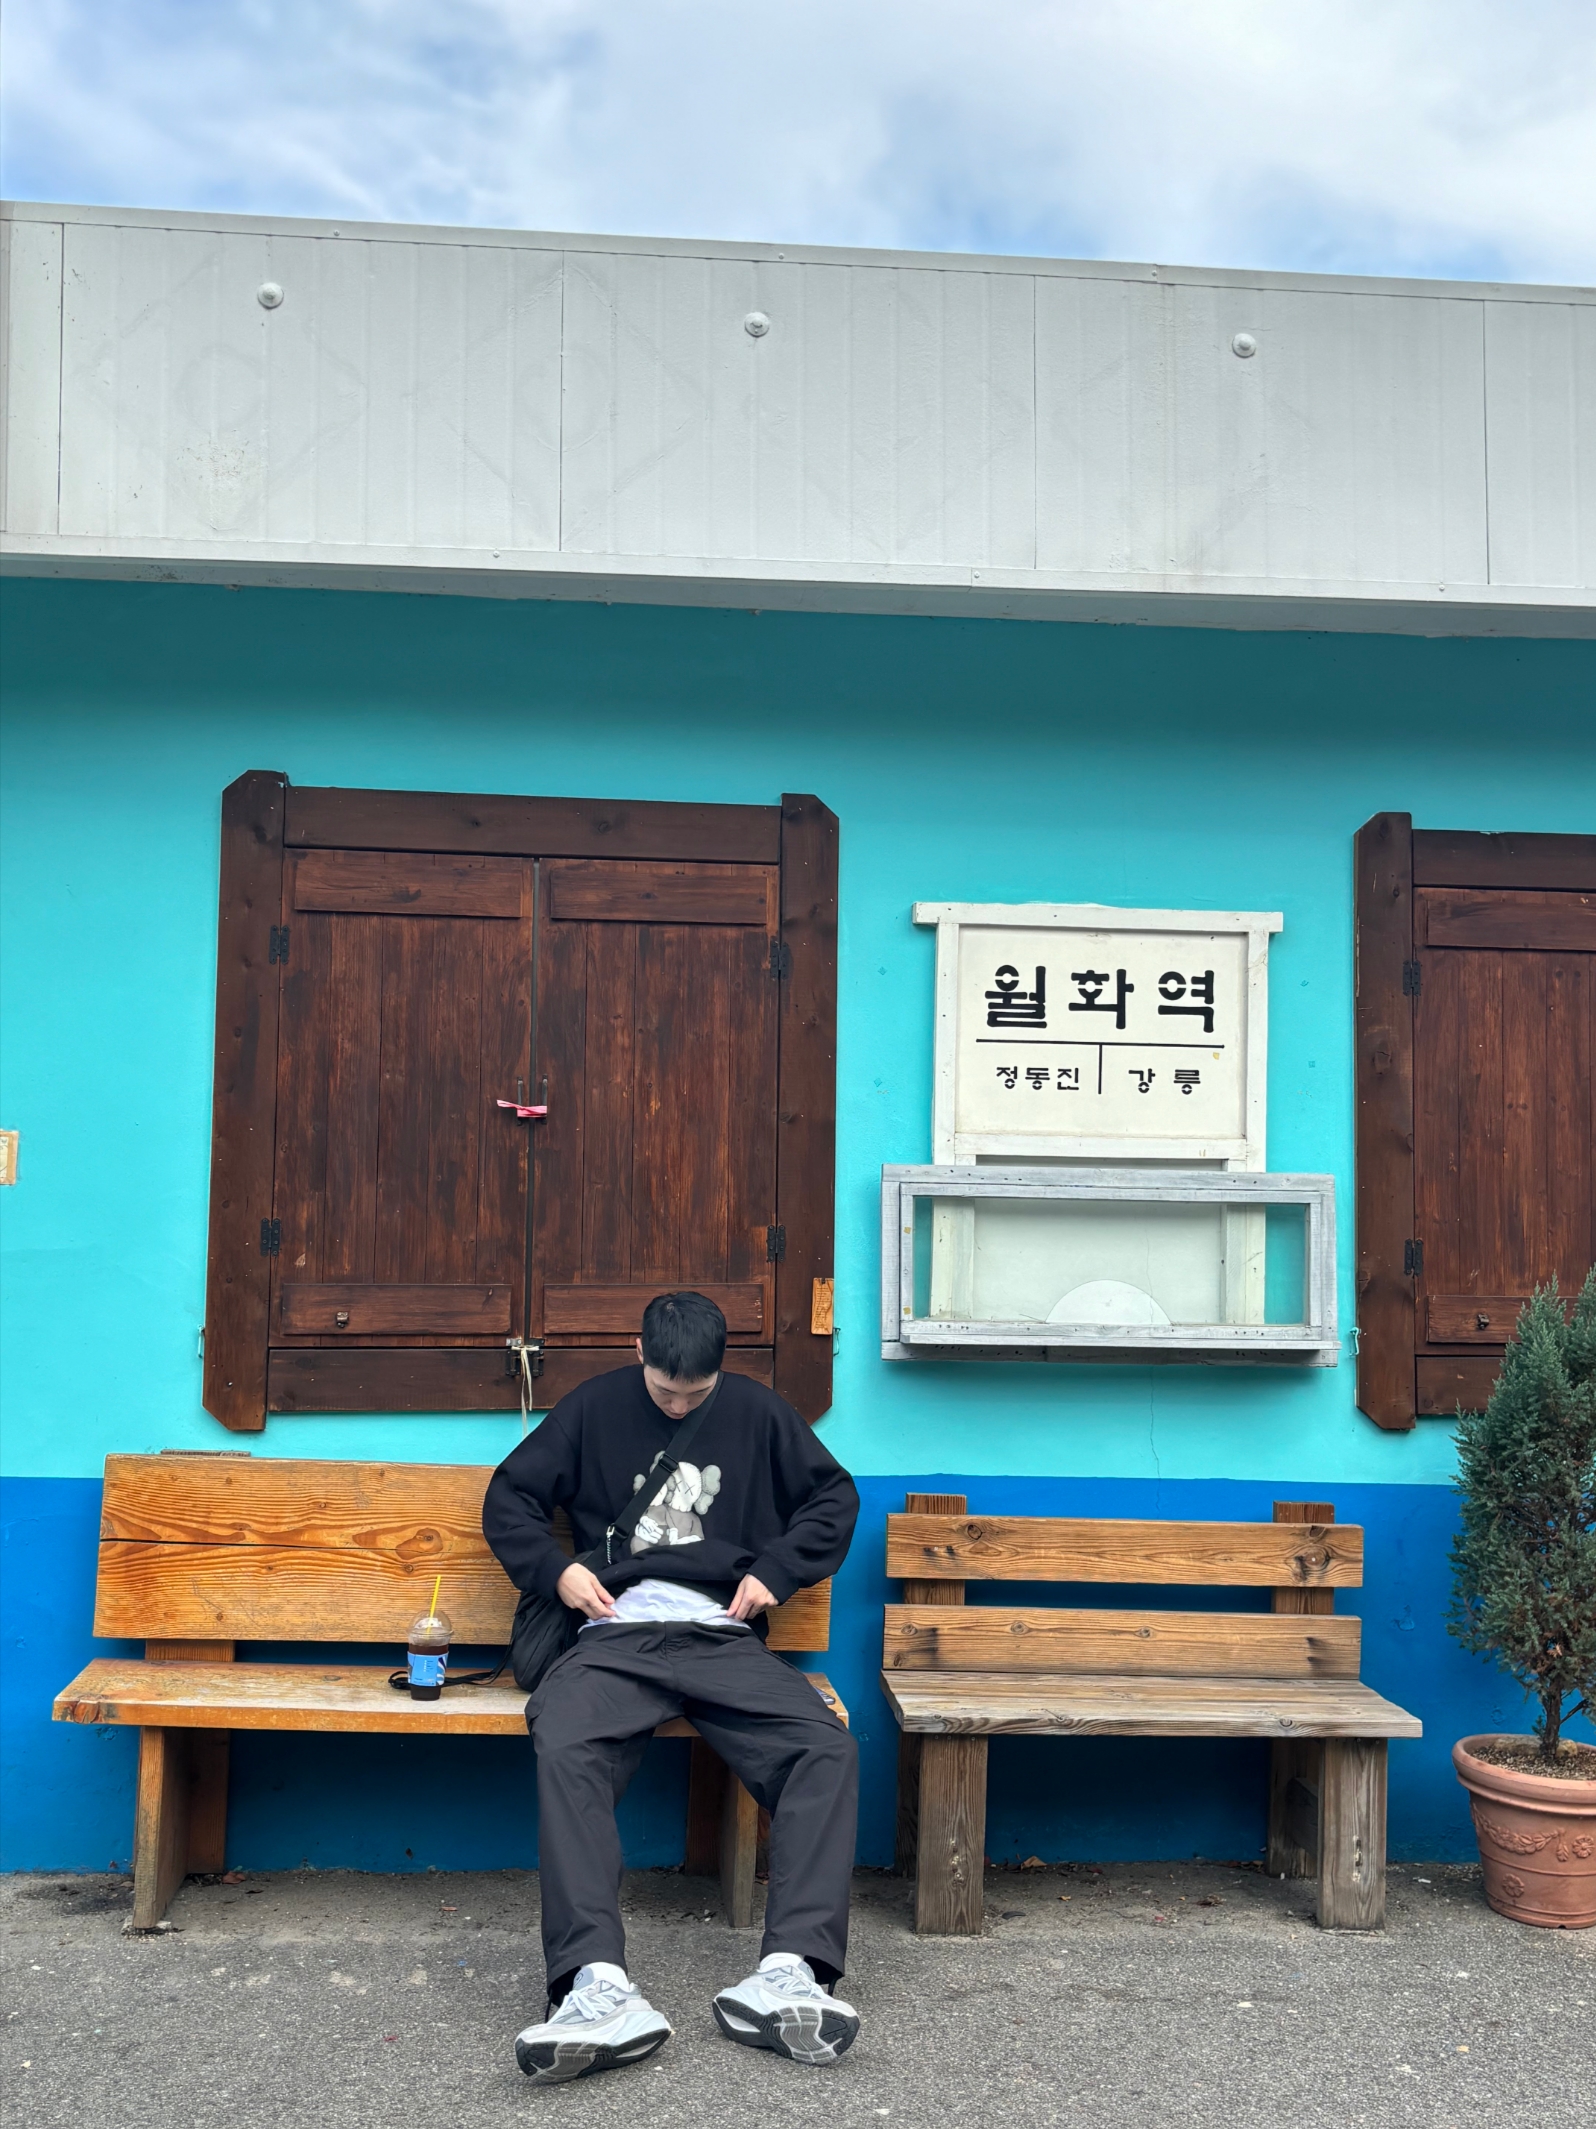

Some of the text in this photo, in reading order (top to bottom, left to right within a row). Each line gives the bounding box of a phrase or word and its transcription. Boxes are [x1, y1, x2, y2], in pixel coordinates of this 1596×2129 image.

[984, 964, 1215, 1034] 월화역
[996, 1066, 1080, 1091] 정동진
[1128, 1068, 1201, 1095] 강릉
